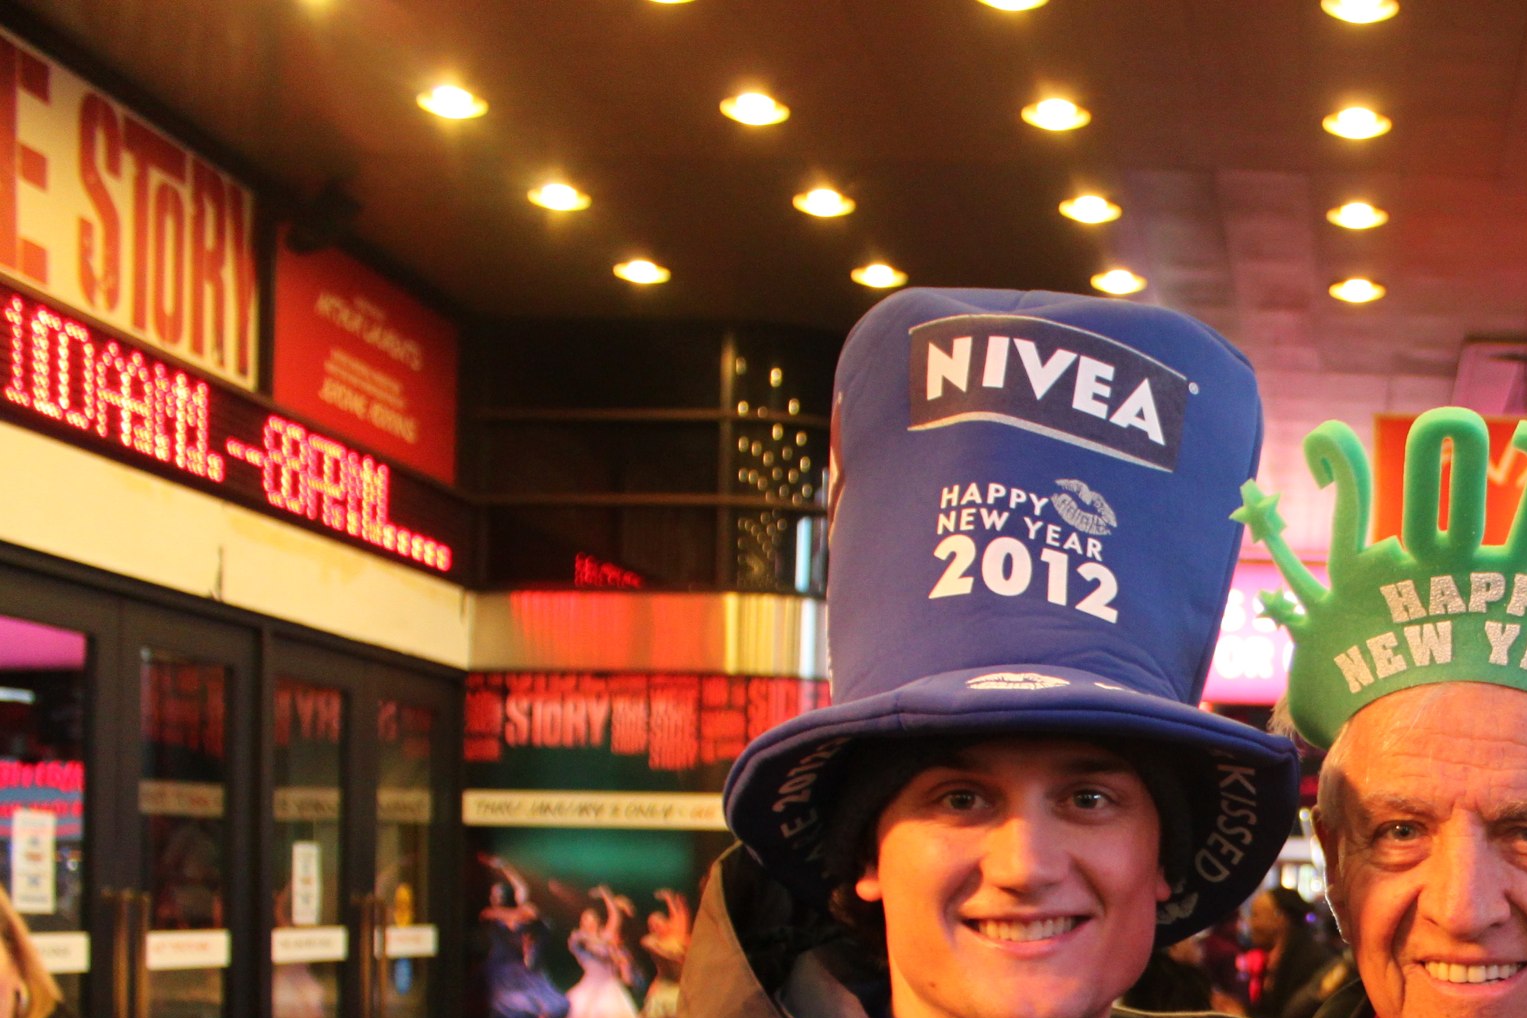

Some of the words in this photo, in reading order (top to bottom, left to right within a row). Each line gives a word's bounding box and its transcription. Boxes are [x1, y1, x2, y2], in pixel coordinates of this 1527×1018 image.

[76, 88, 258, 378] STORY
[926, 335, 1166, 447] NIVEA
[936, 506, 1010, 536] NEW
[1023, 515, 1104, 562] YEAR
[940, 484, 1049, 515] HAPPY
[927, 534, 1120, 624] 2012
[1333, 620, 1453, 694] NEW
[1194, 764, 1257, 883] KISSED
